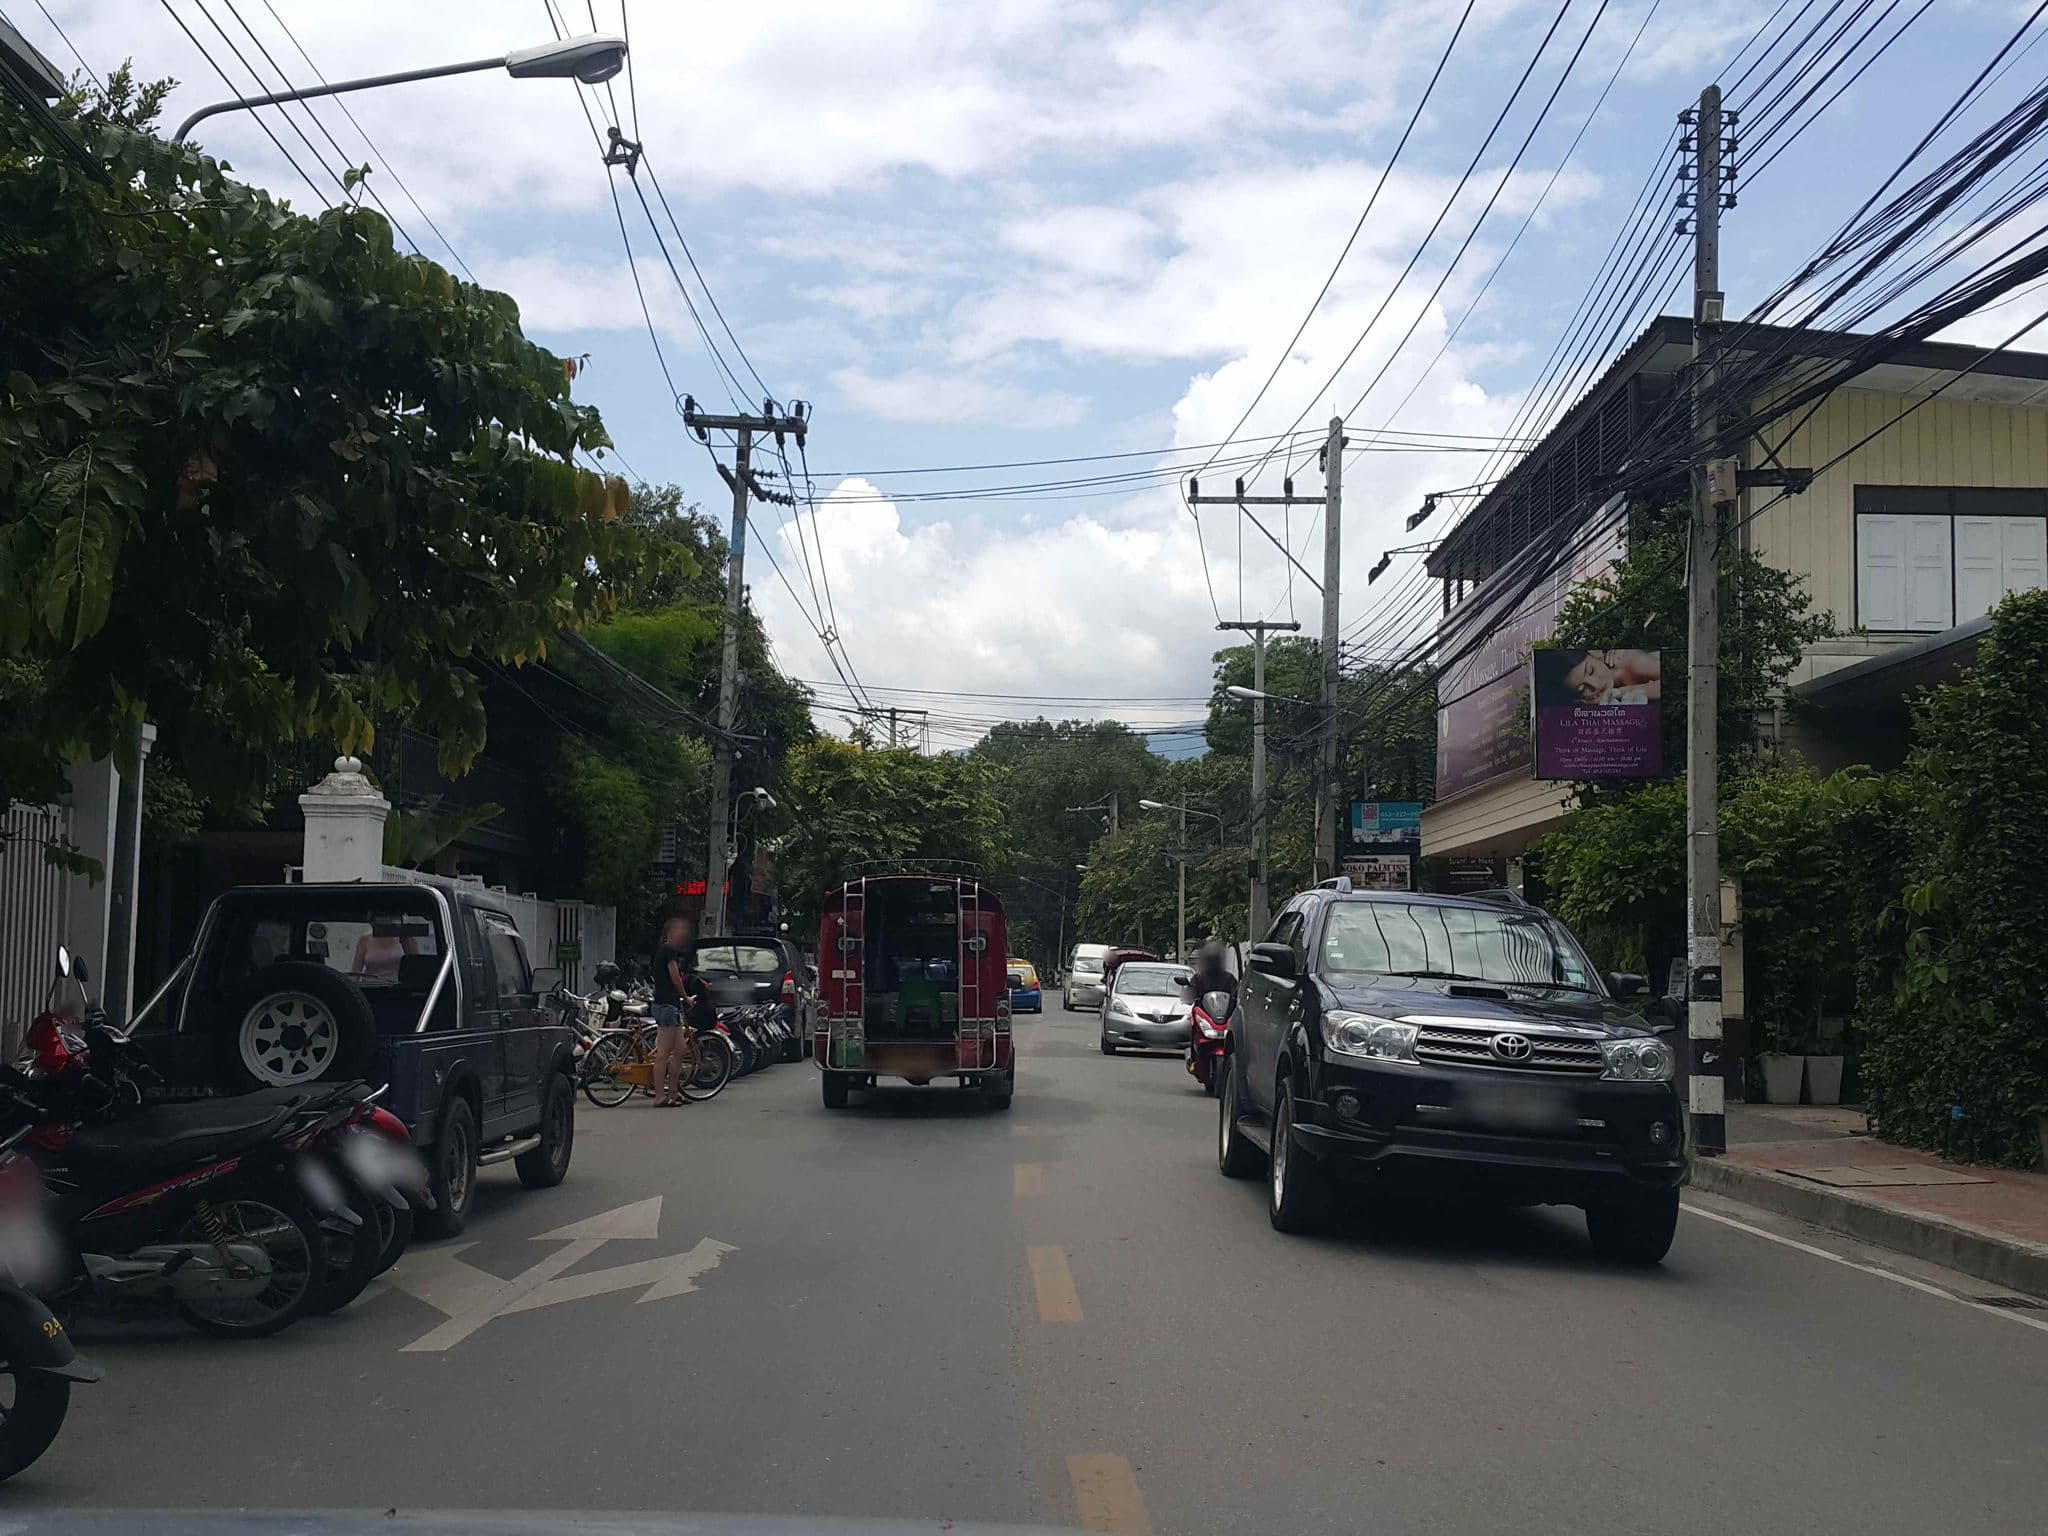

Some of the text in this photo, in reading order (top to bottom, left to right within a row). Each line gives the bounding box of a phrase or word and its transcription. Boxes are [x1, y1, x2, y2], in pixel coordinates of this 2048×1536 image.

[1559, 718, 1641, 727] LILA THAI MASSAGE
[1366, 864, 1390, 872] PALM
